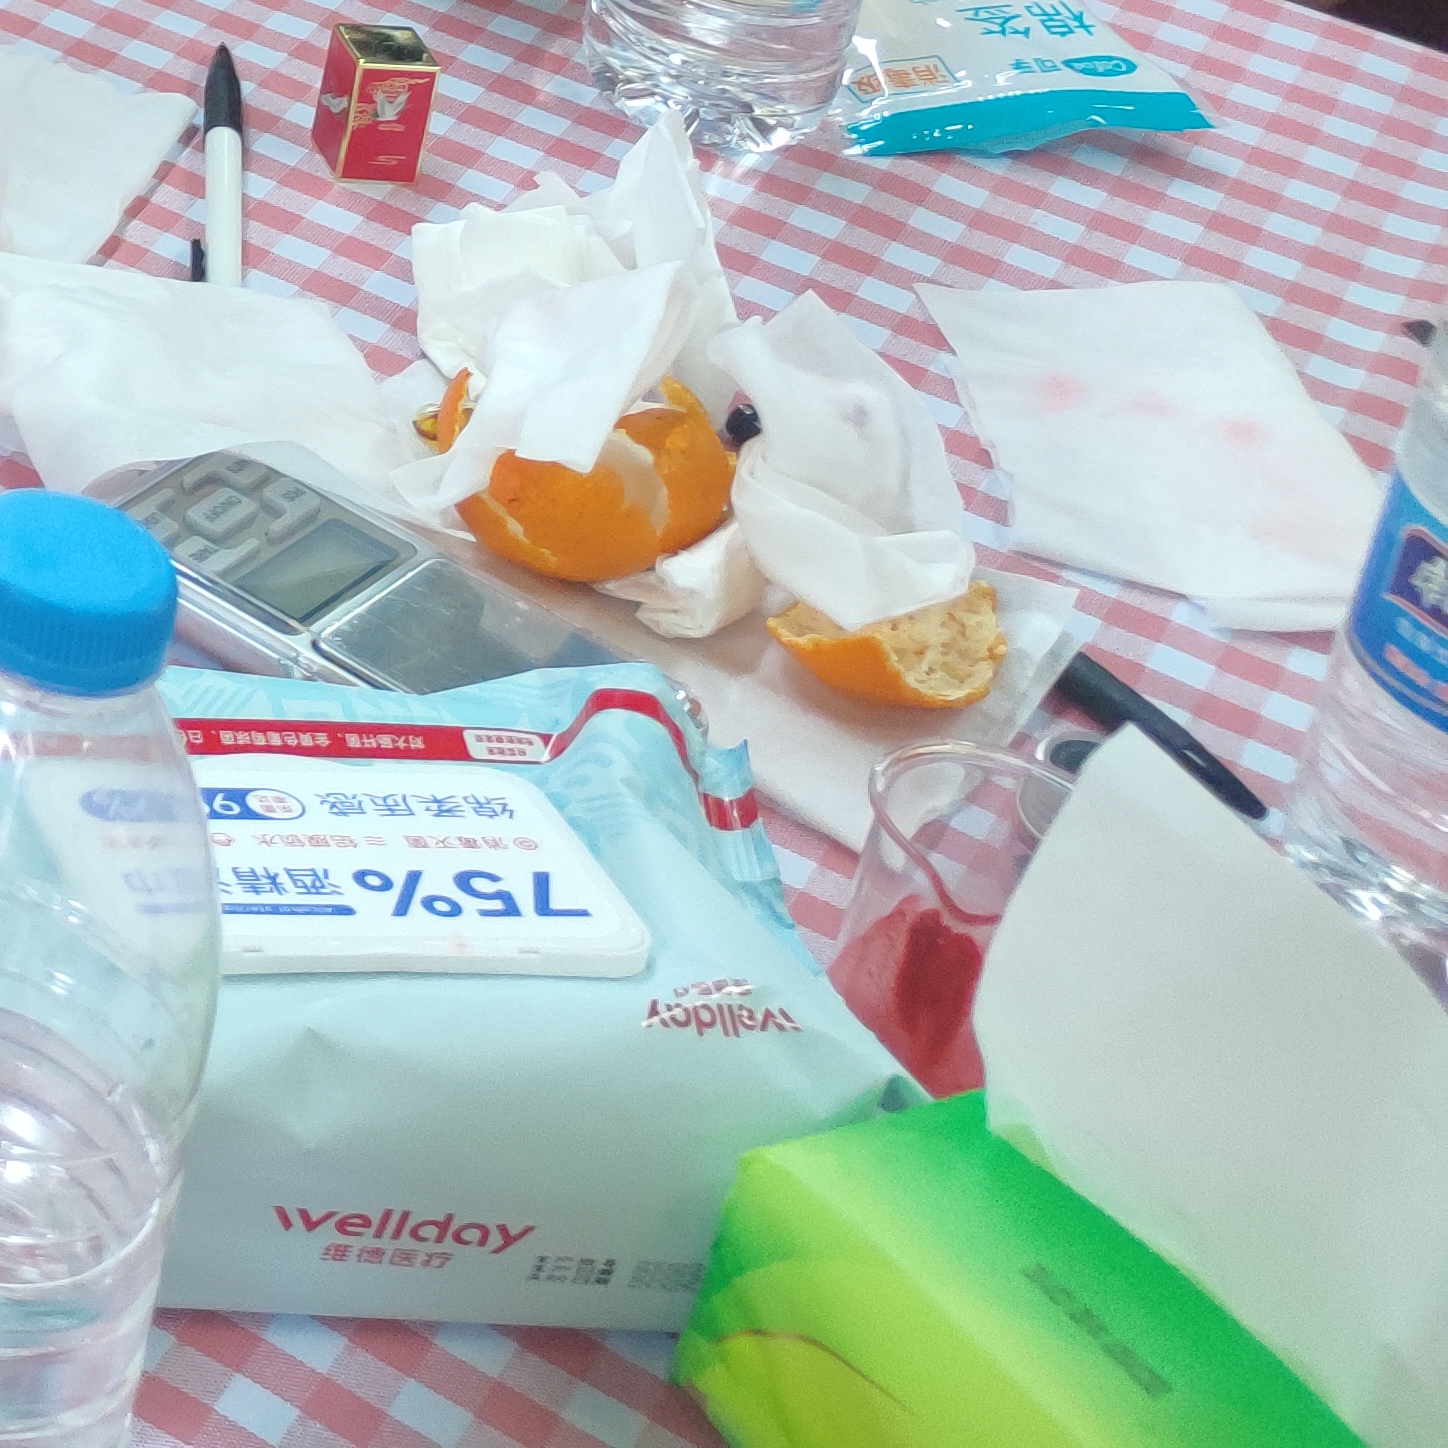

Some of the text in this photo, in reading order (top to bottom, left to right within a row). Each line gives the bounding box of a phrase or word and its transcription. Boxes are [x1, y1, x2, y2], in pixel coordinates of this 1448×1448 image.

[955, 0, 1096, 39] 棉签
[313, 792, 517, 821] 绵柔质感
[352, 868, 594, 918] 75%
[272, 1204, 538, 1255] wellday
[319, 1242, 455, 1270] 维德医疗
